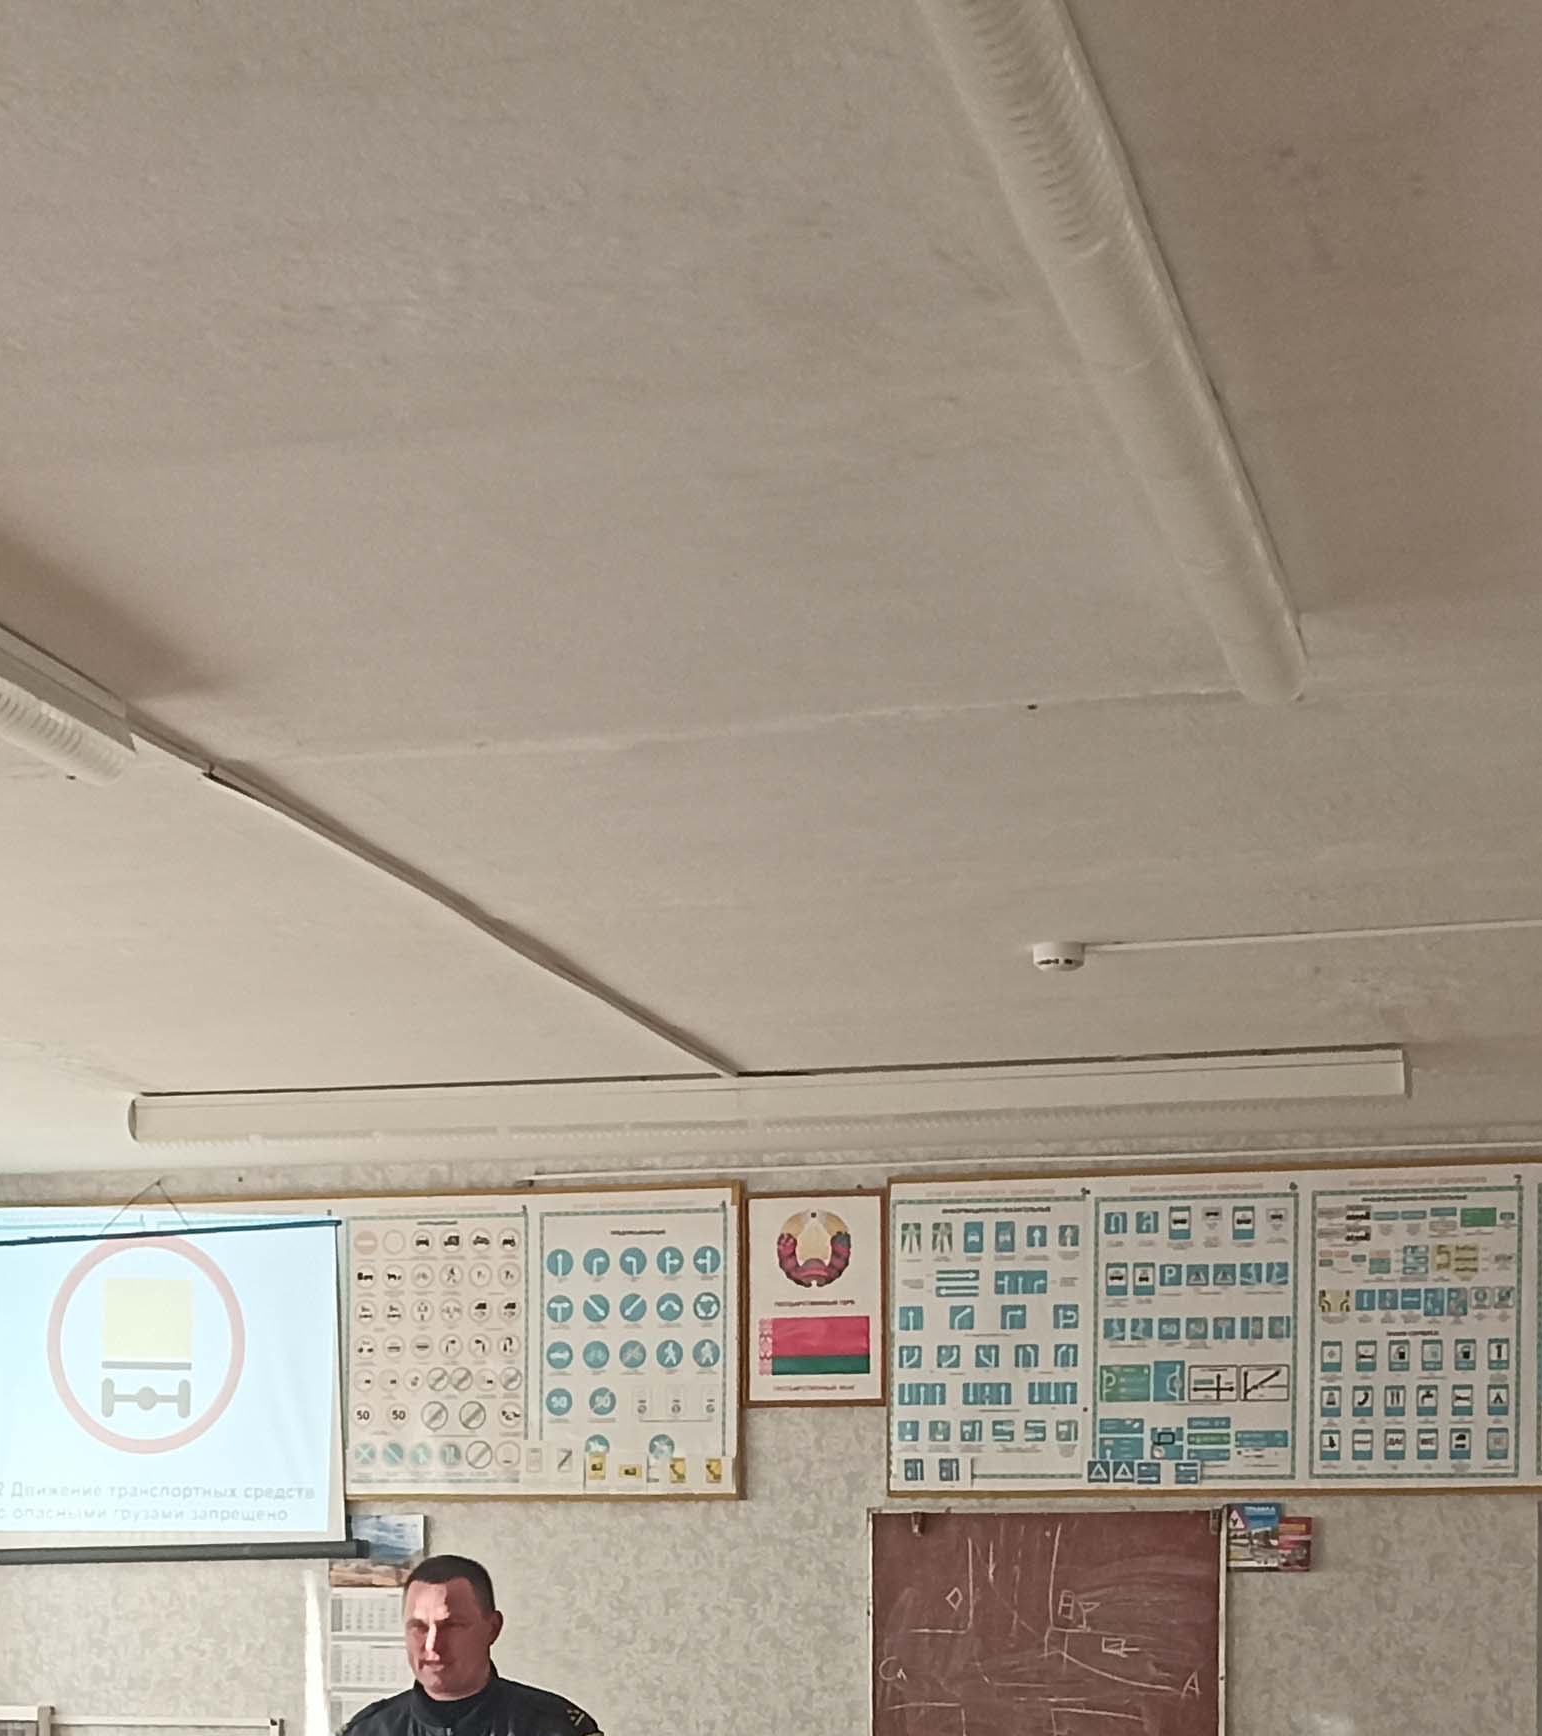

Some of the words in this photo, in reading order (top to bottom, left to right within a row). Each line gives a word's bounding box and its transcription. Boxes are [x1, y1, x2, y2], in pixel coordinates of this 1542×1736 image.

[356, 1409, 370, 1420] 50
[391, 1409, 406, 1420] 50
[10, 1482, 102, 1500] Движение
[109, 1484, 236, 1500] транспортных
[244, 1485, 316, 1502] средств
[12, 1508, 107, 1521] опасными
[113, 1508, 185, 1523] грузами
[190, 1508, 289, 1523] запрещено
